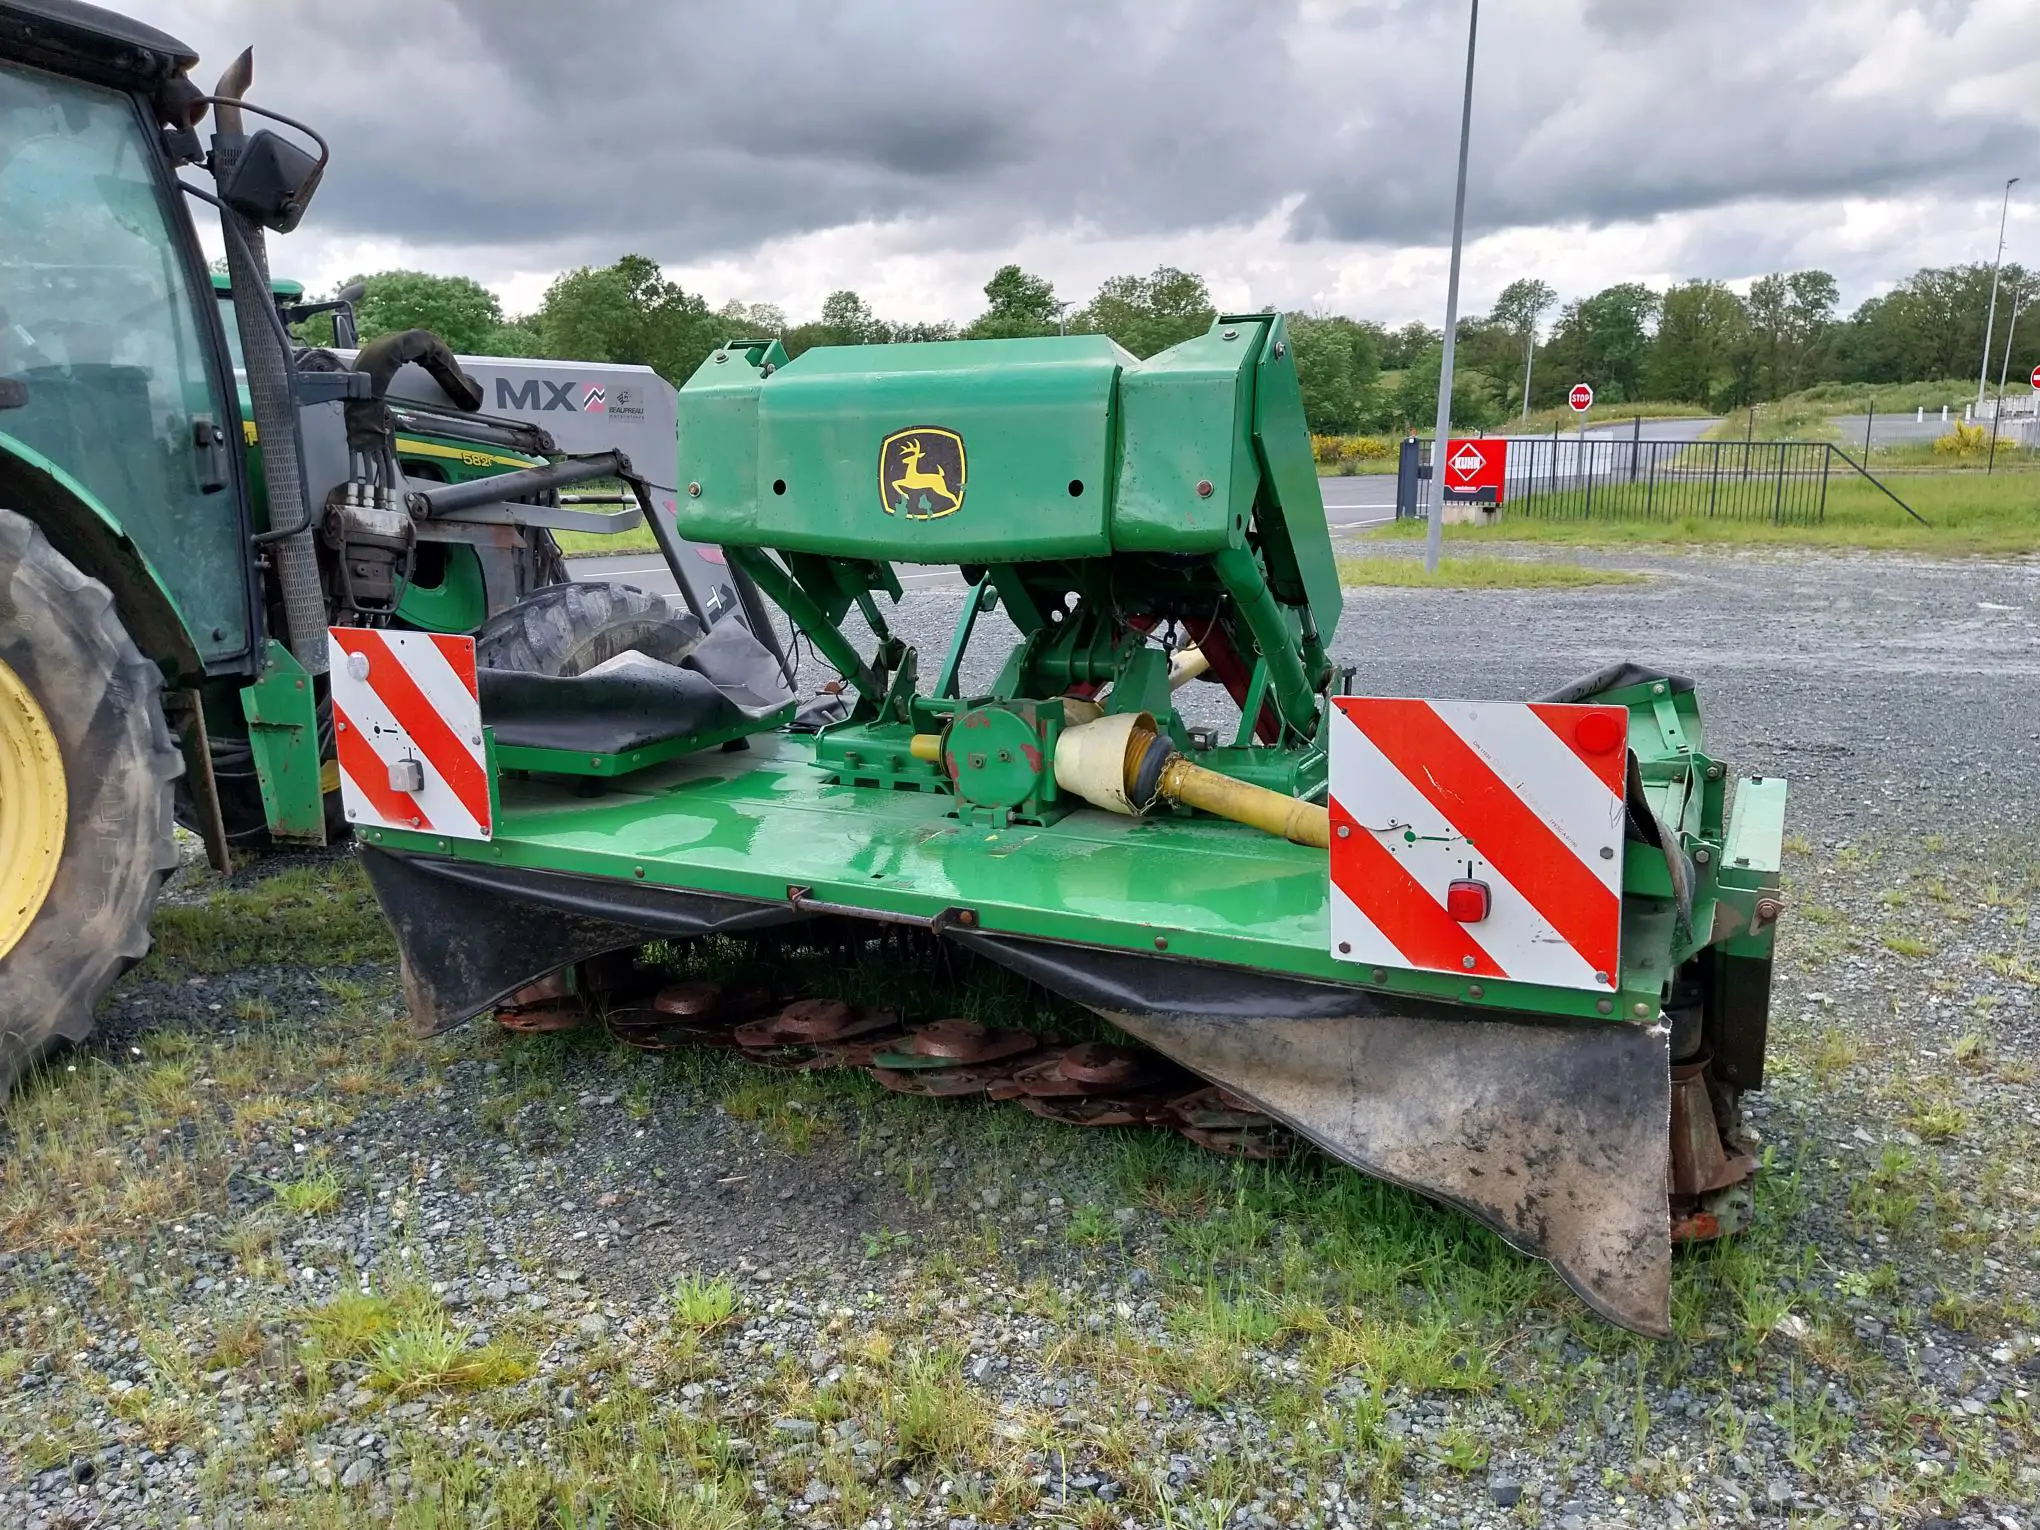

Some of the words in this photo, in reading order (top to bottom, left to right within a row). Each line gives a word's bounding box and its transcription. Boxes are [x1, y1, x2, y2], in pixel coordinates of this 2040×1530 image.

[495, 377, 577, 412] MX
[1571, 393, 1590, 403] STOP
[1454, 456, 1481, 470] KUHN
